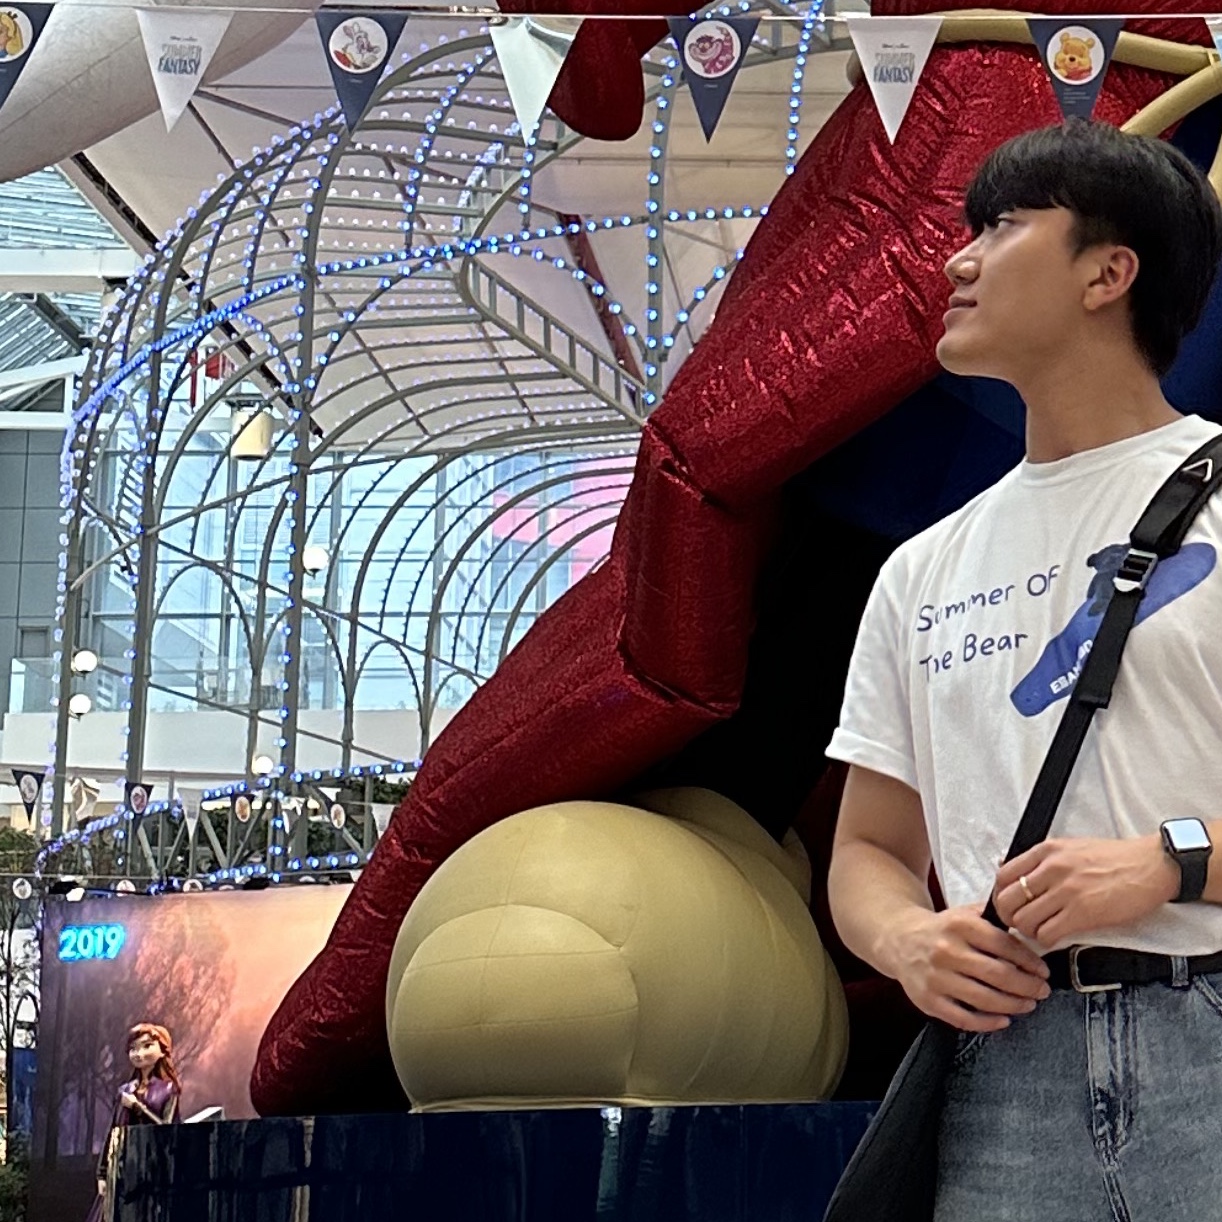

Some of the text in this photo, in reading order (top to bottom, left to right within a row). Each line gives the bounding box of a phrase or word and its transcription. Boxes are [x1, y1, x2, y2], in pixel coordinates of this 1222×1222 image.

[158, 56, 201, 75] FANTASY
[873, 65, 914, 83] FANTASY
[963, 633, 1028, 662] Bear
[59, 924, 126, 962] 2019
